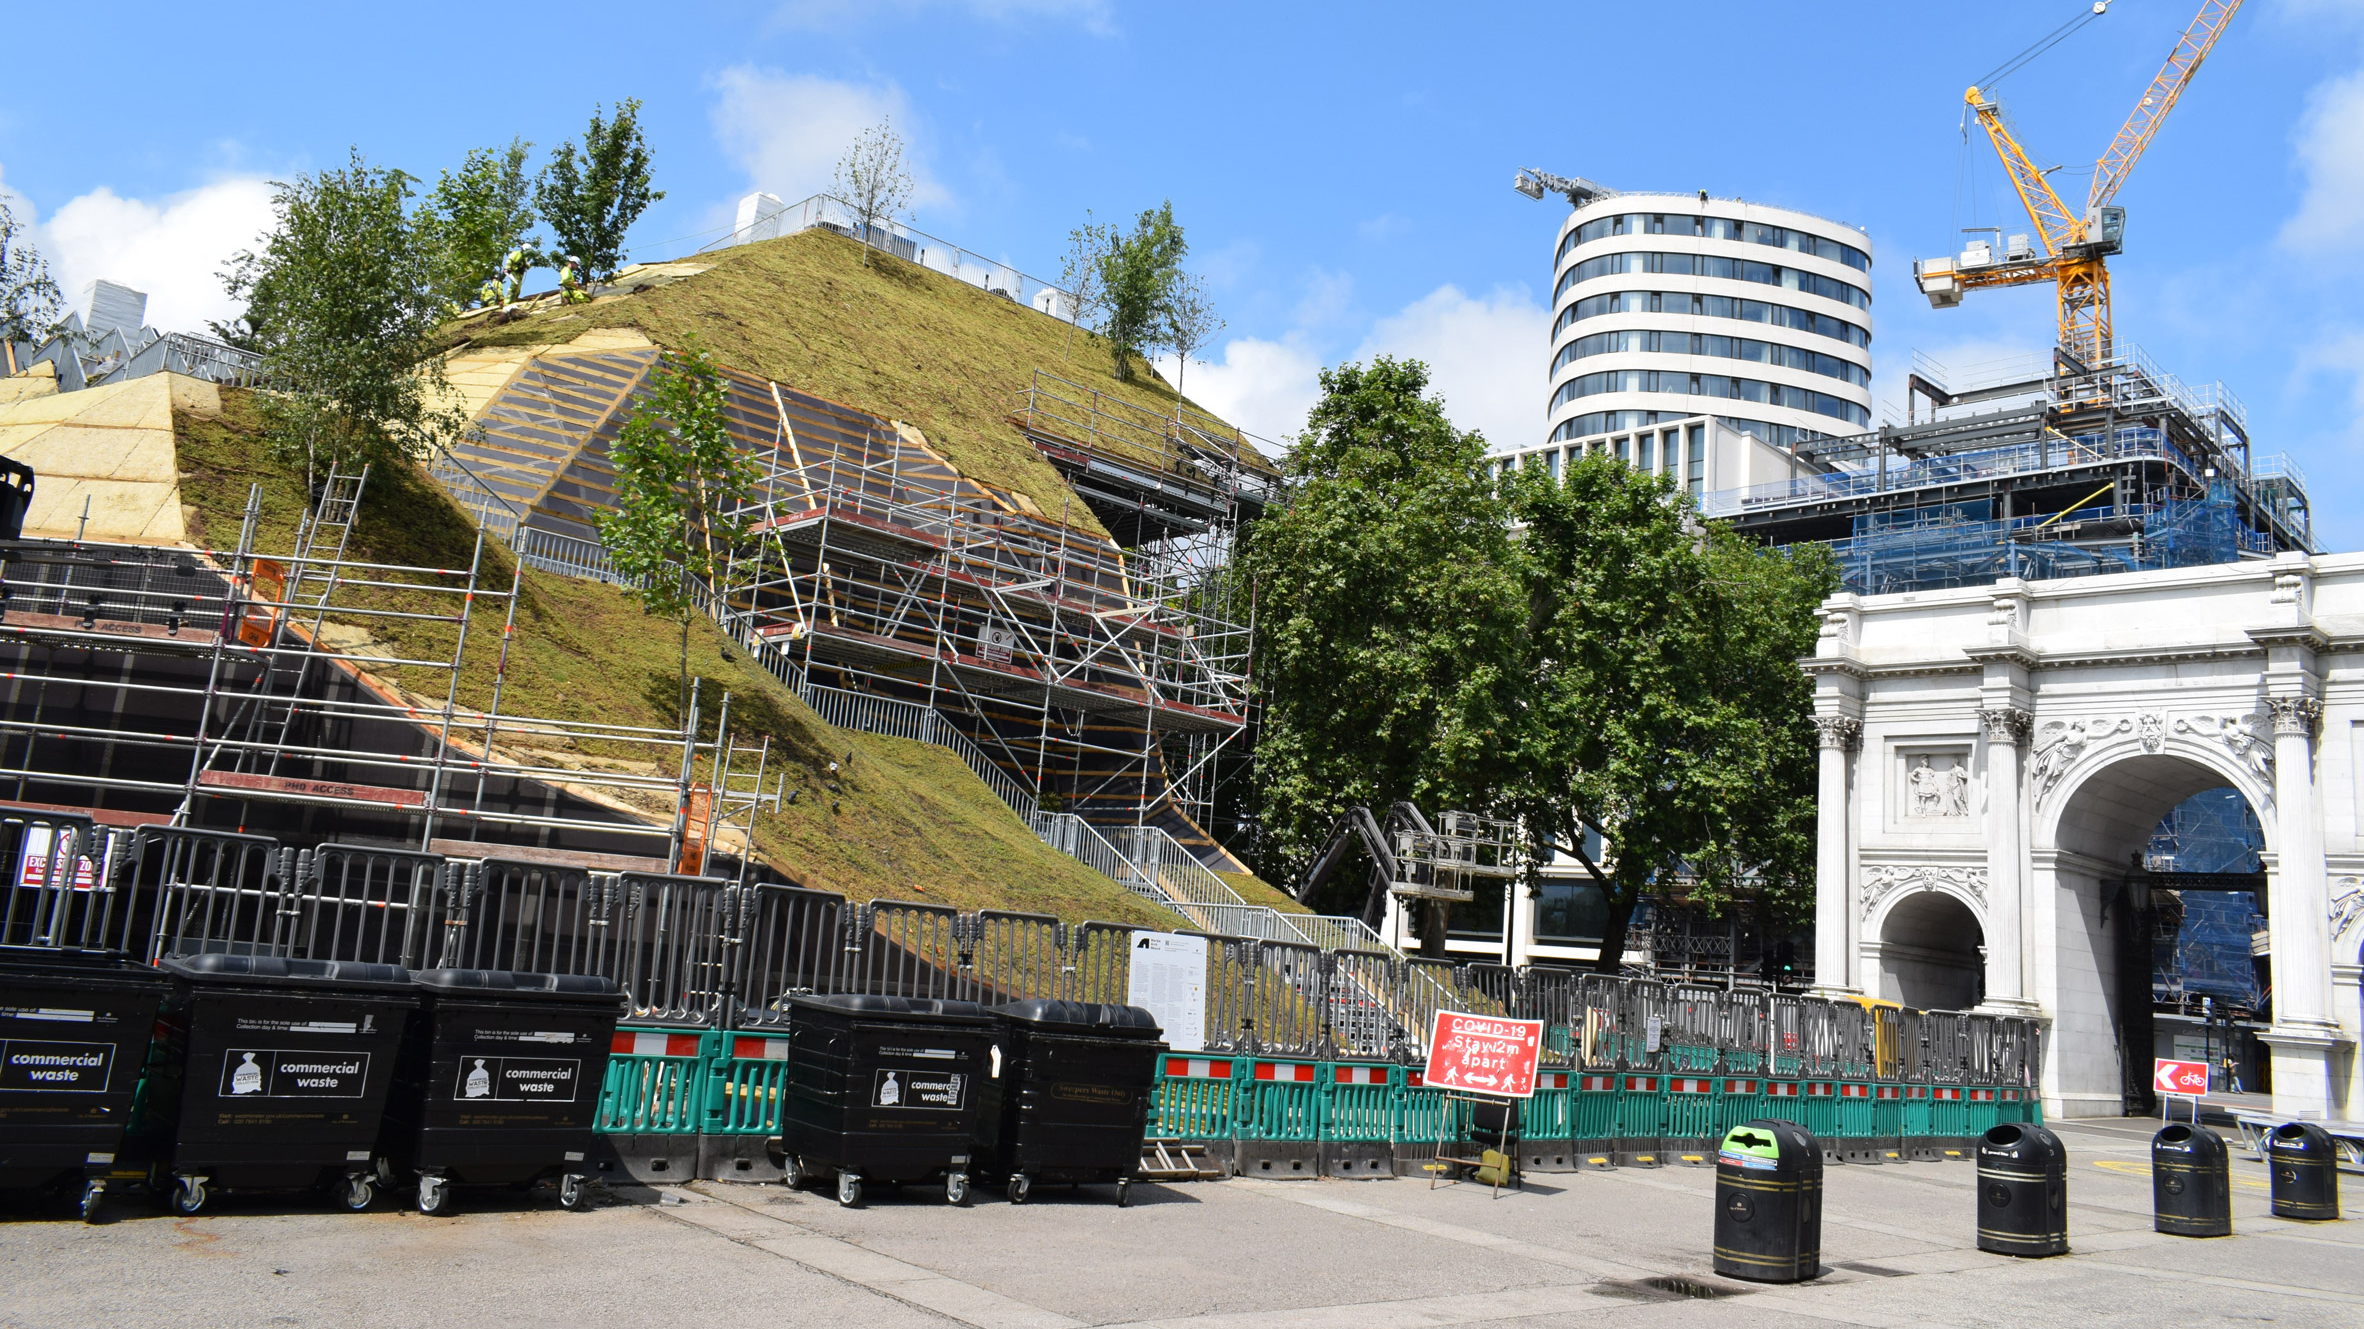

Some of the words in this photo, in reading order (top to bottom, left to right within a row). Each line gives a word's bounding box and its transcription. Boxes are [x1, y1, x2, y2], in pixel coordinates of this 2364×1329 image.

[101, 623, 142, 634] ACCESS
[284, 781, 306, 791] PHD
[312, 785, 354, 795] ACCESS
[1452, 1018, 1527, 1037] COVID-19
[1454, 1035, 1492, 1054] Stay
[1497, 1040, 1519, 1055] 2m
[11, 1053, 104, 1067] commercial
[1461, 1056, 1506, 1070] apart
[280, 1061, 359, 1074] commercial
[506, 1067, 572, 1080] commercial
[31, 1069, 79, 1081] waste
[297, 1077, 338, 1088] waste
[519, 1082, 554, 1092] waste
[911, 1081, 951, 1091] commerc
[1092, 1086, 1109, 1096] Waste
[922, 1093, 948, 1102] waste
